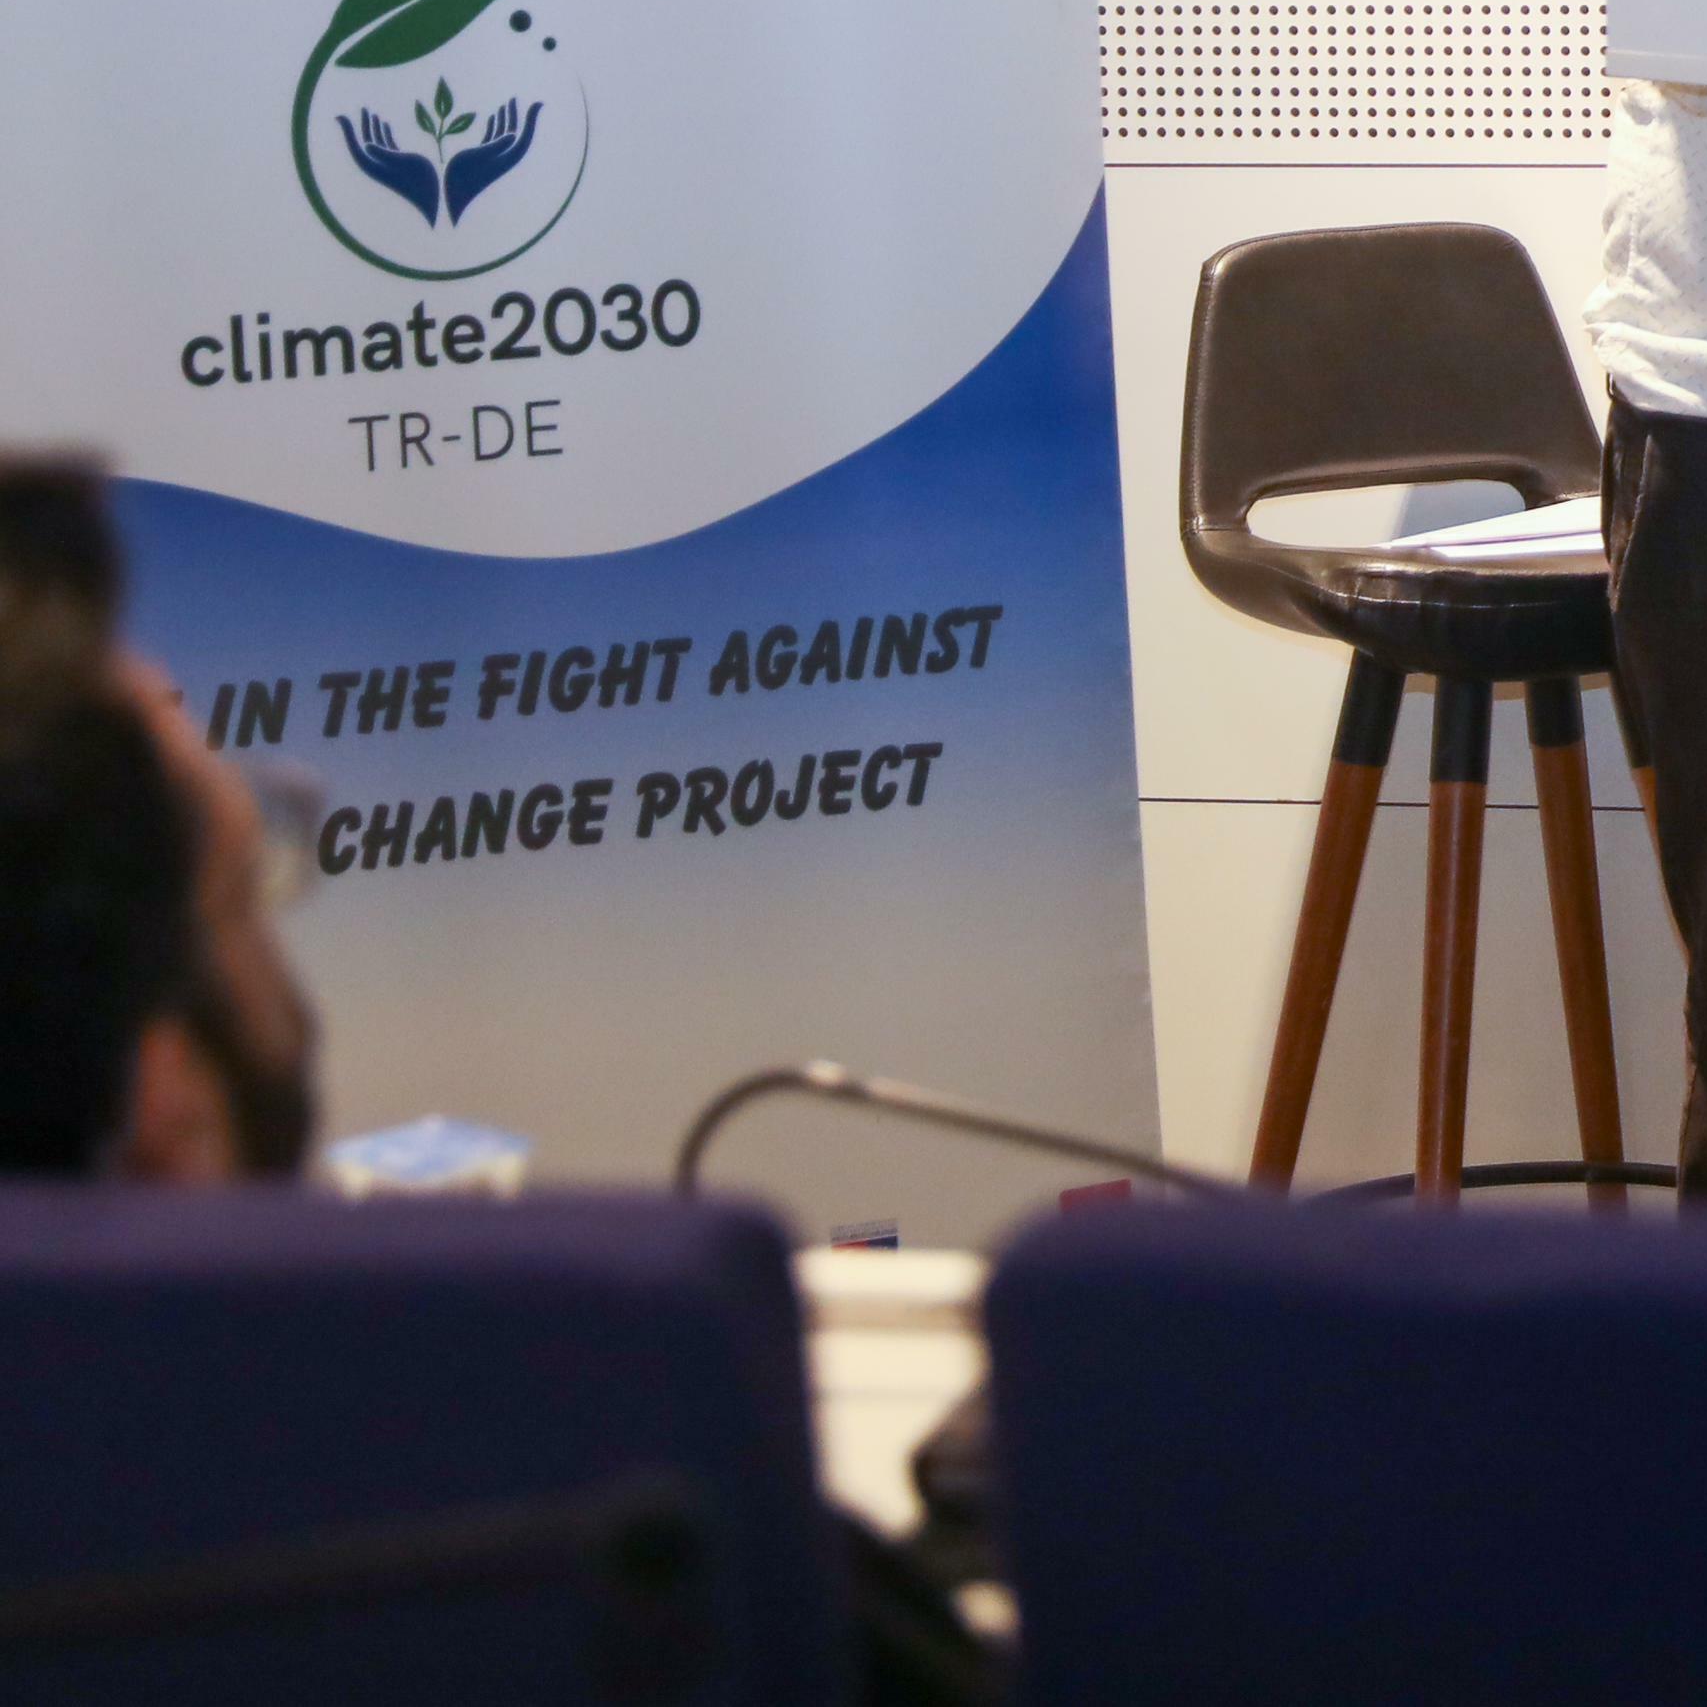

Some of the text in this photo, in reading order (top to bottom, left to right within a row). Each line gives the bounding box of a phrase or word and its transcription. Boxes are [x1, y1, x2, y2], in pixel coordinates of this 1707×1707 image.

[181, 279, 700, 387] climate2030
[348, 400, 563, 471] TR-DE
[203, 605, 1003, 755] IN THE FIGHT AGAINST
[312, 742, 943, 875] CHANGE PROJECT
